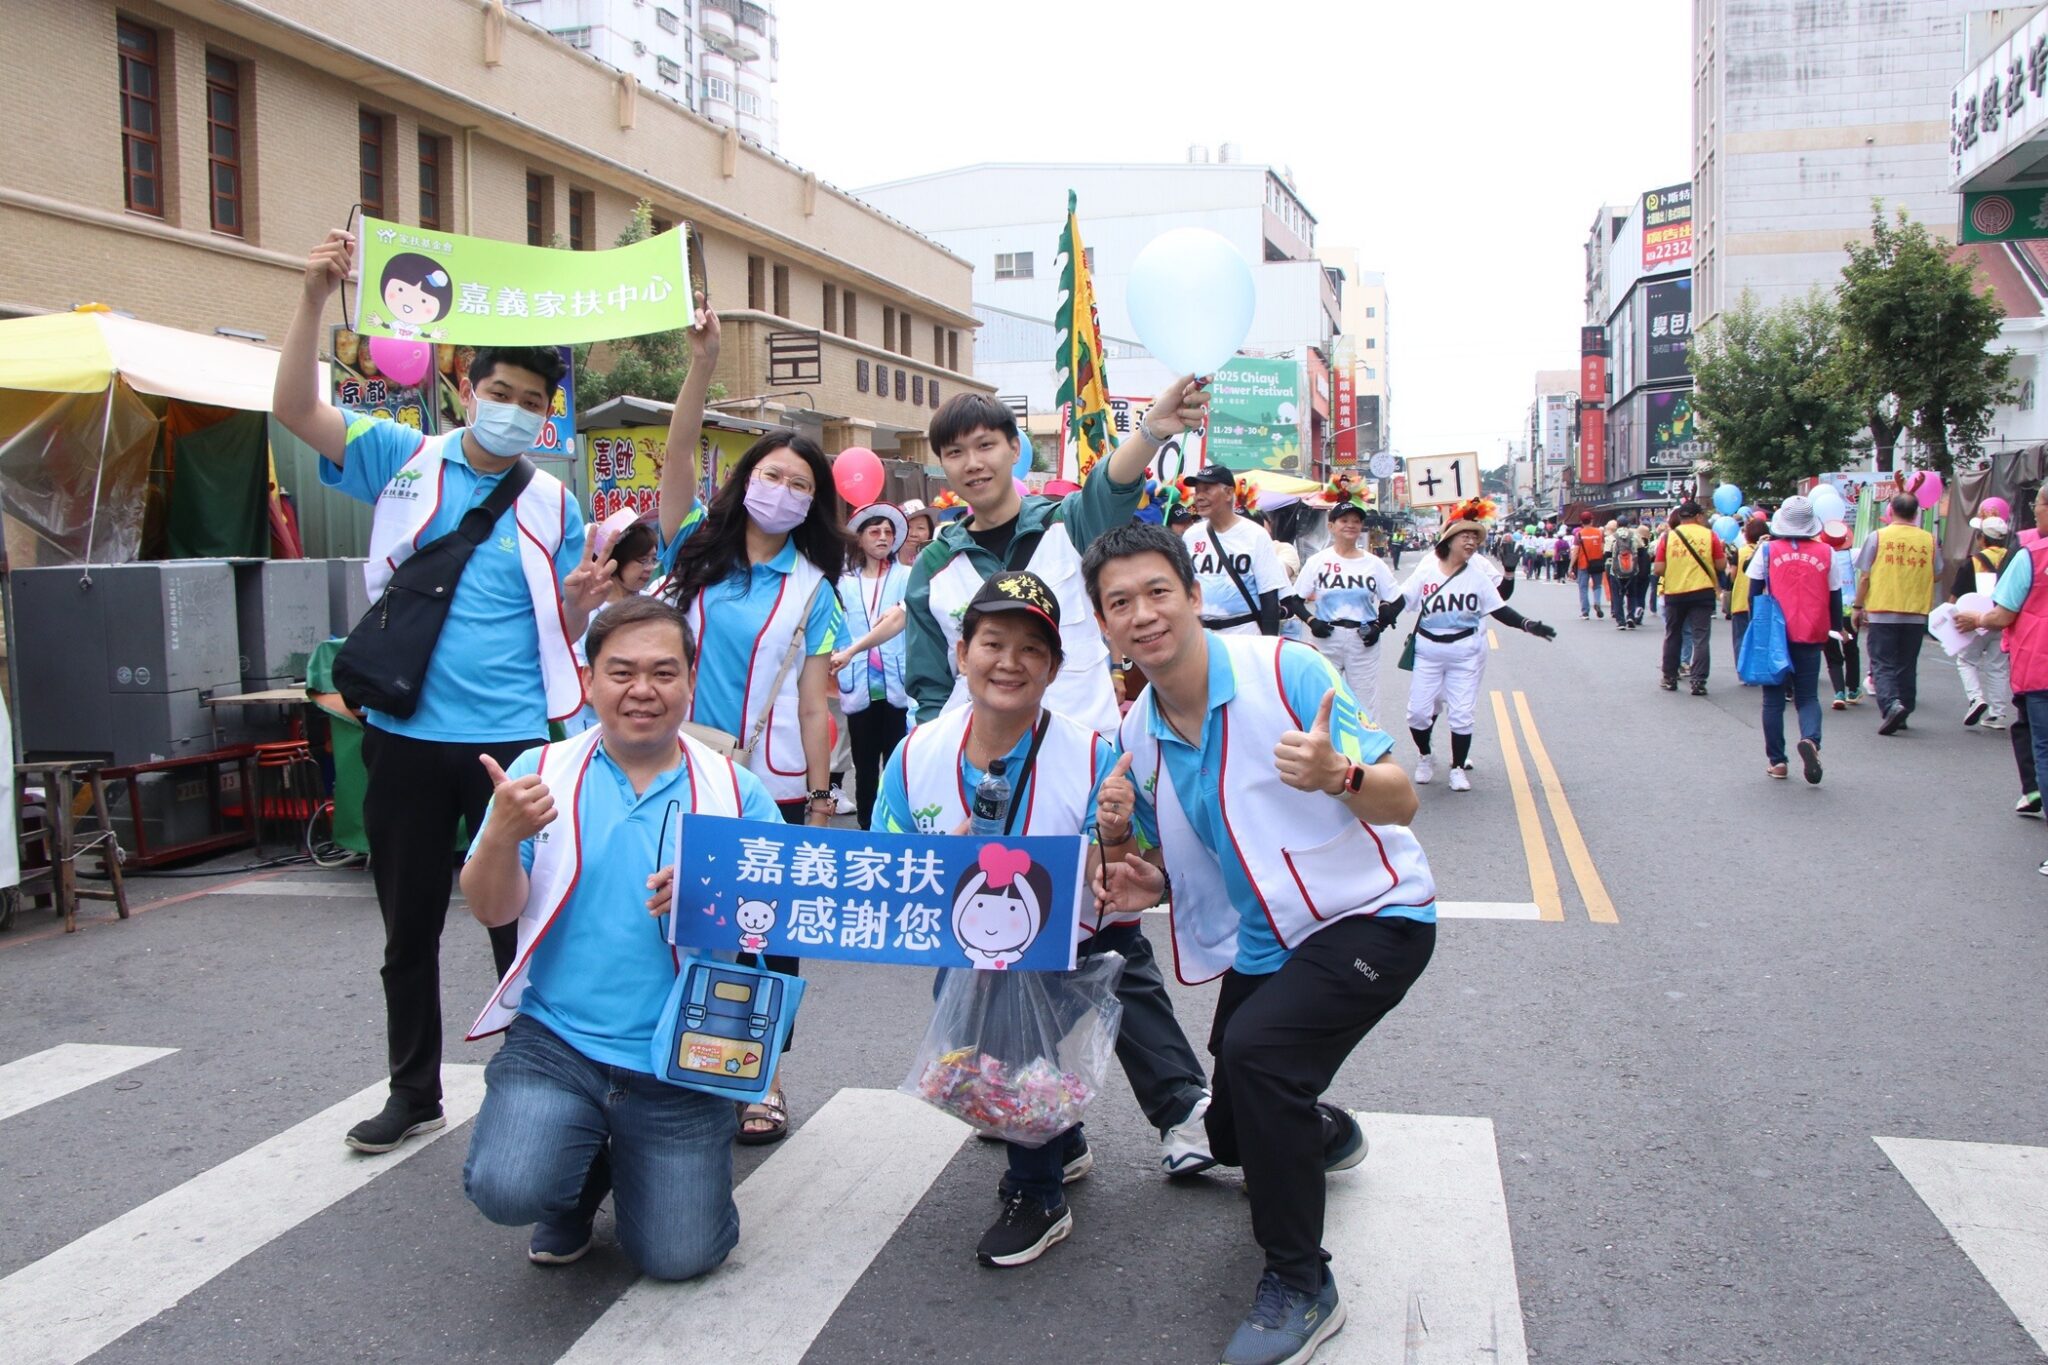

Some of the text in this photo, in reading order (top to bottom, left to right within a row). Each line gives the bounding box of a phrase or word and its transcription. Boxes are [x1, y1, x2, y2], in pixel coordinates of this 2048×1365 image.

[399, 233, 453, 252] 家扶基金會
[458, 275, 672, 318] 嘉義家扶中心
[1214, 371, 1279, 386] 2025 Chiayi
[342, 378, 387, 404] 京都
[1213, 384, 1294, 397] Flower Festival
[1194, 541, 1206, 553] 80
[1324, 562, 1341, 574] 76
[1318, 572, 1377, 593] KANO
[1423, 583, 1438, 596] 80
[1421, 593, 1478, 614] KANO
[735, 837, 944, 896] 嘉義家扶
[786, 896, 943, 951] 感謝您
